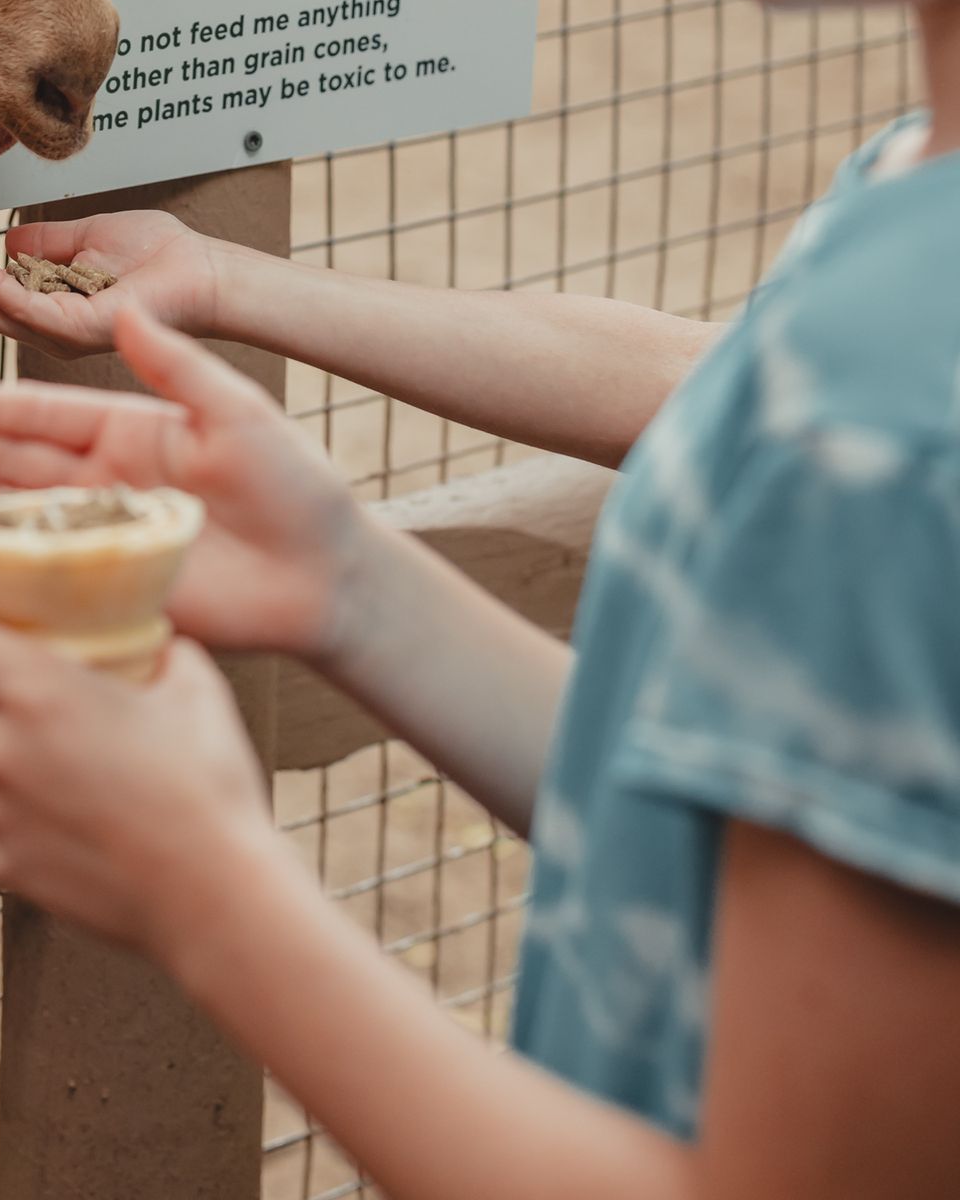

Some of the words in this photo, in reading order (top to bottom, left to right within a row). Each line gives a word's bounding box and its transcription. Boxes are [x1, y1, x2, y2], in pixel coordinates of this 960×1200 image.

[105, 66, 174, 94] other
[181, 56, 235, 82] than
[244, 42, 305, 76] grain
[313, 33, 388, 60] cones,
[140, 26, 182, 53] not
[190, 14, 245, 45] feed
[253, 13, 290, 35] me
[137, 93, 213, 130] plants
[221, 85, 272, 110] may
[280, 77, 310, 100] be
[318, 65, 376, 94] toxic
[384, 62, 408, 83] to
[415, 56, 455, 78] me.
